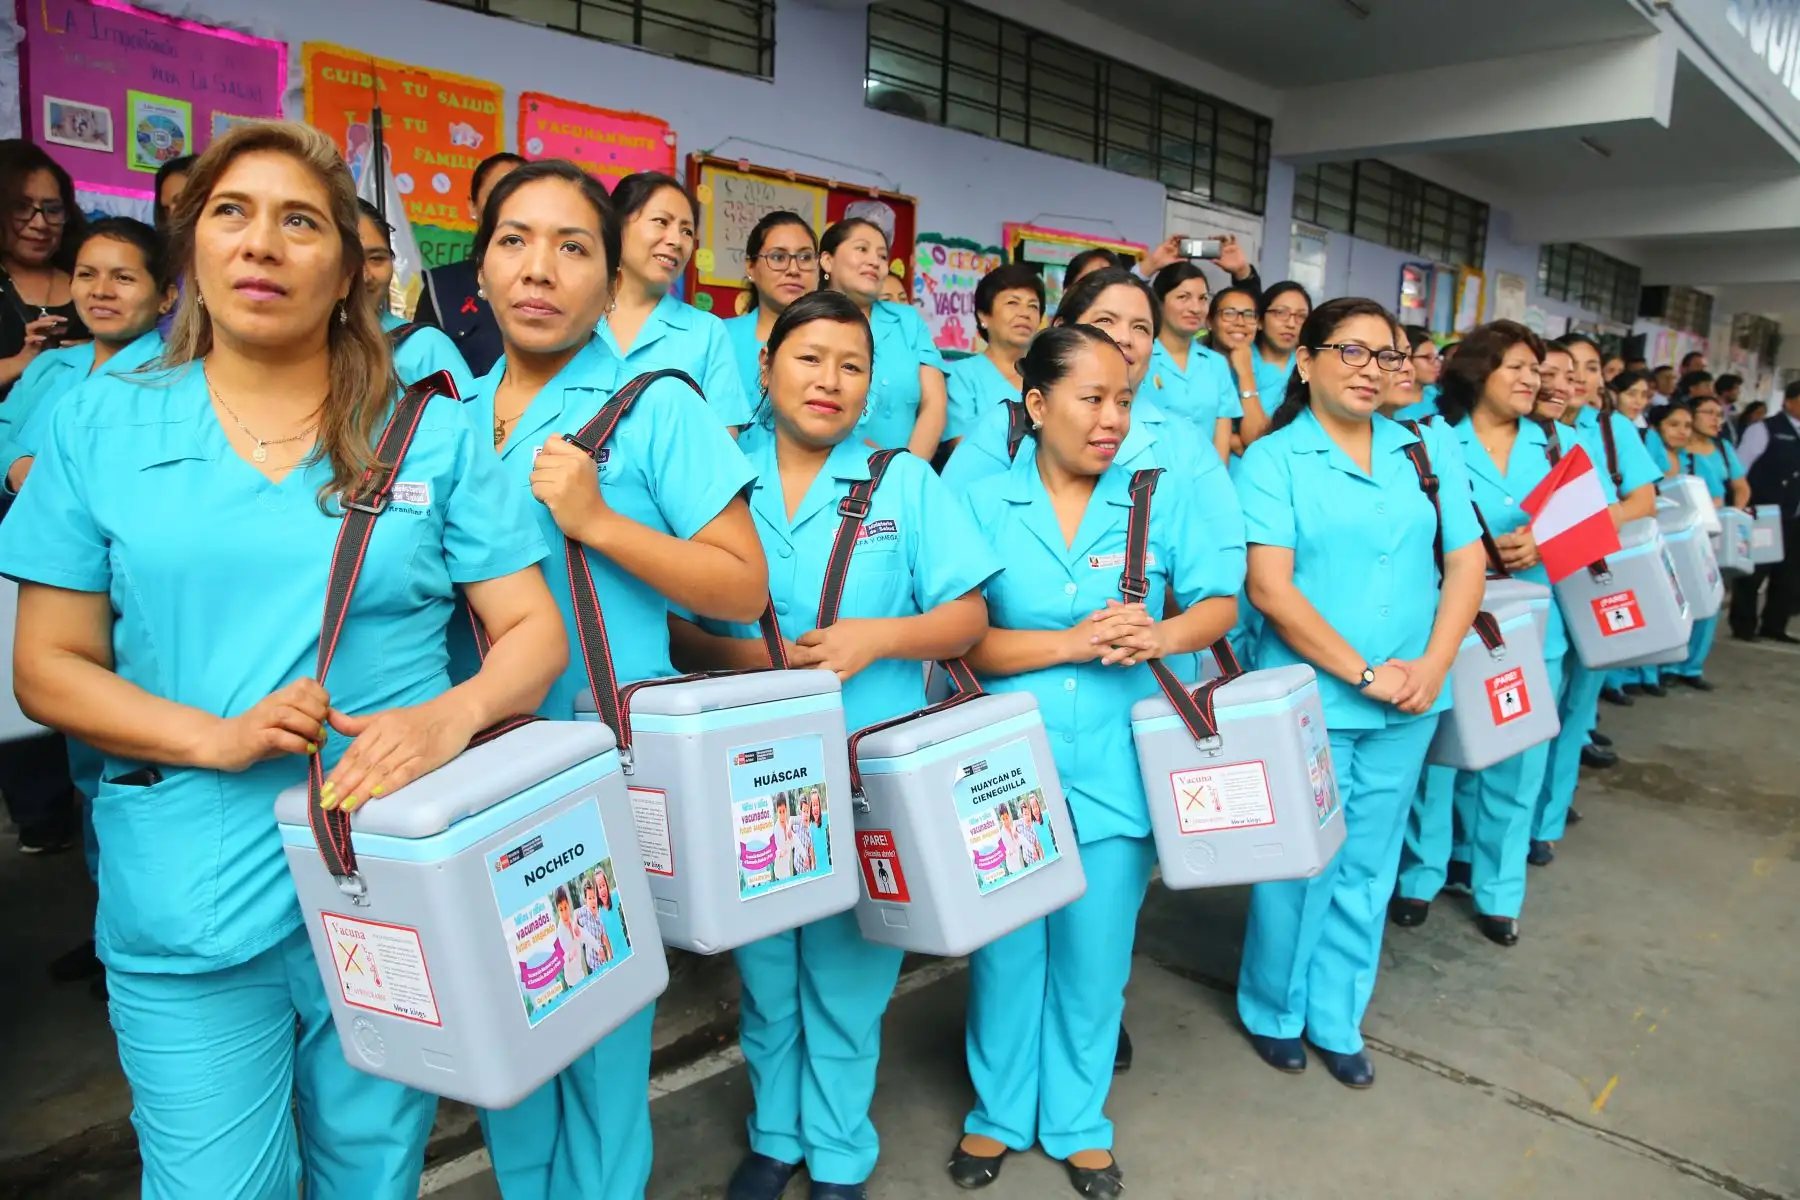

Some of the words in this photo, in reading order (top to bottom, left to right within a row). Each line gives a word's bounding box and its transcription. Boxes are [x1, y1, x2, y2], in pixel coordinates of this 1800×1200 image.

[402, 82, 428, 99] TU
[437, 90, 497, 116] SALUD
[402, 117, 428, 134] TU
[413, 147, 482, 172] FAMILI
[754, 767, 808, 788] HUÁSCAR
[1010, 767, 1023, 778] DE
[1179, 775, 1212, 785] Vacuna
[972, 778, 1026, 805] CIENEGUILLA
[863, 835, 889, 848] ¡PARE!
[524, 843, 585, 887] NOCHETO
[332, 921, 366, 940] Vacuna
